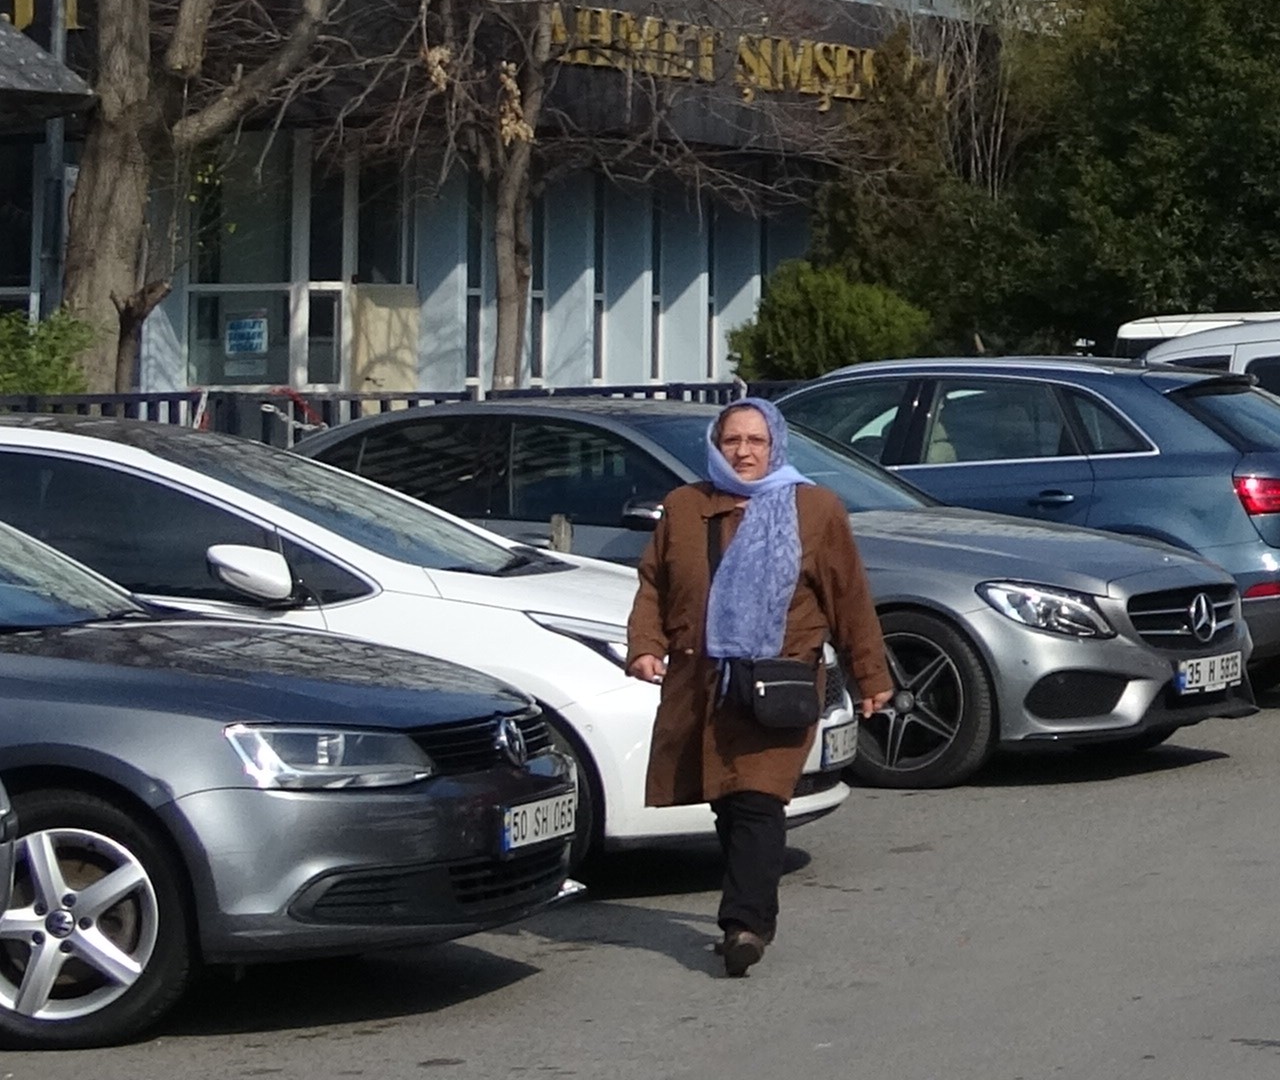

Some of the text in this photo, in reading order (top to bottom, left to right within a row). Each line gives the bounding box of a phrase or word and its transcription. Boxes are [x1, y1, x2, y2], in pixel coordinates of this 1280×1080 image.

[1188, 661, 1202, 685] 35
[1209, 659, 1216, 682] H
[513, 798, 574, 842] 50 SH 065
